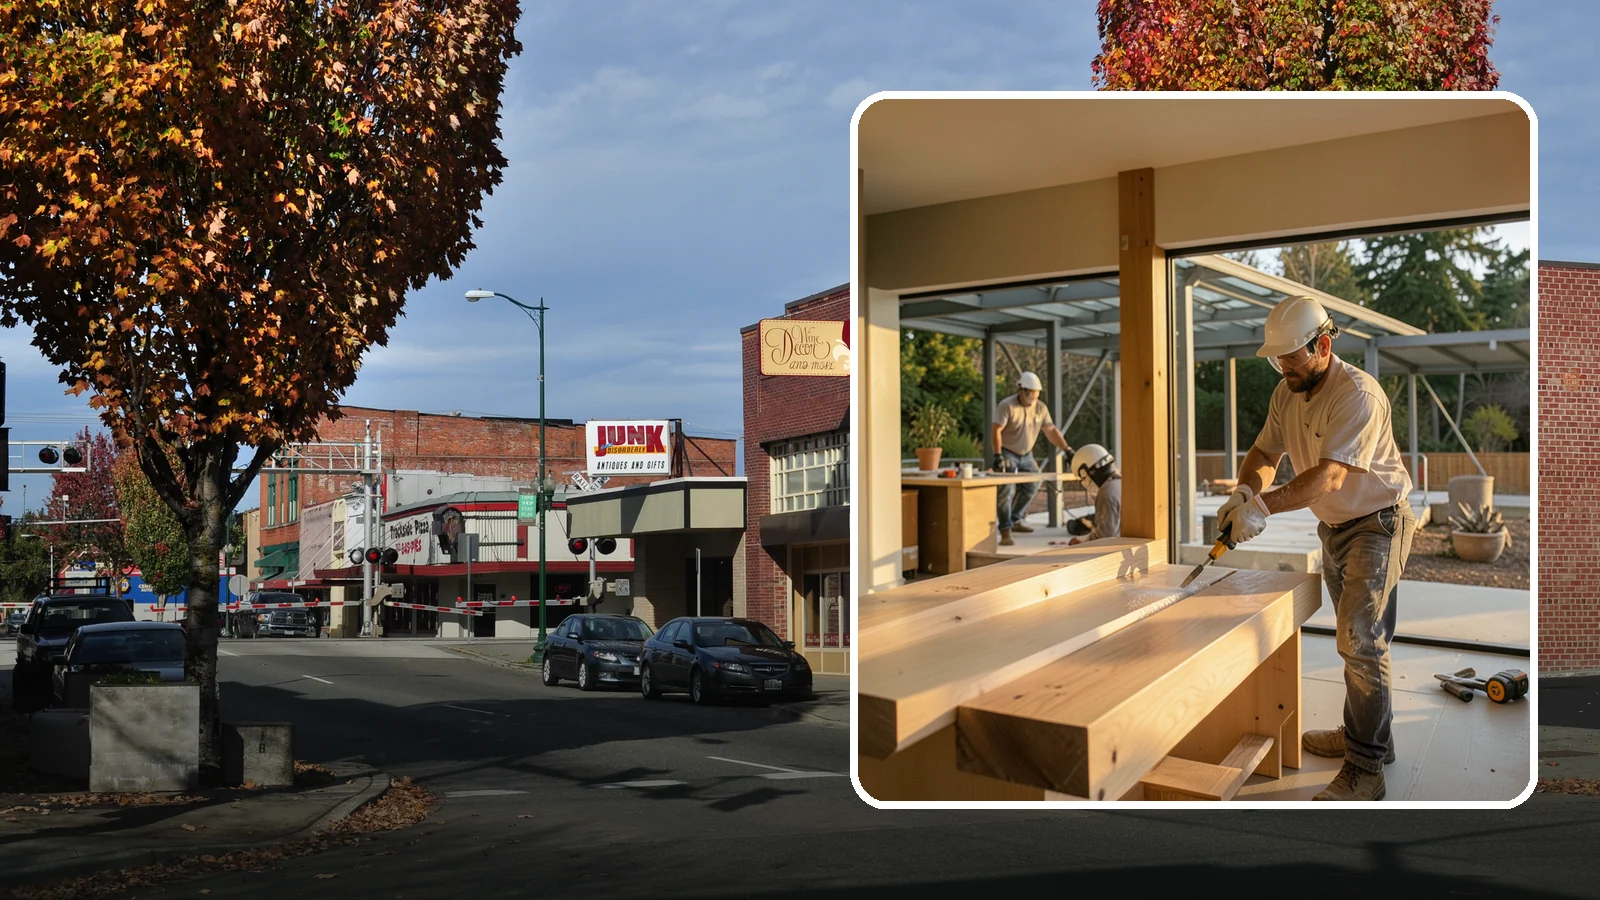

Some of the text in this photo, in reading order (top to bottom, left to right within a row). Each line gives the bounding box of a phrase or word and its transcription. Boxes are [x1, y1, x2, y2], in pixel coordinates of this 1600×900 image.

[765, 328, 831, 365] Decor
[596, 425, 665, 457] JUNK
[607, 446, 646, 454] DISORDERLY
[596, 460, 665, 470] ANTIQUES AND GIFTS
[390, 519, 429, 539] Trackside Pizza
